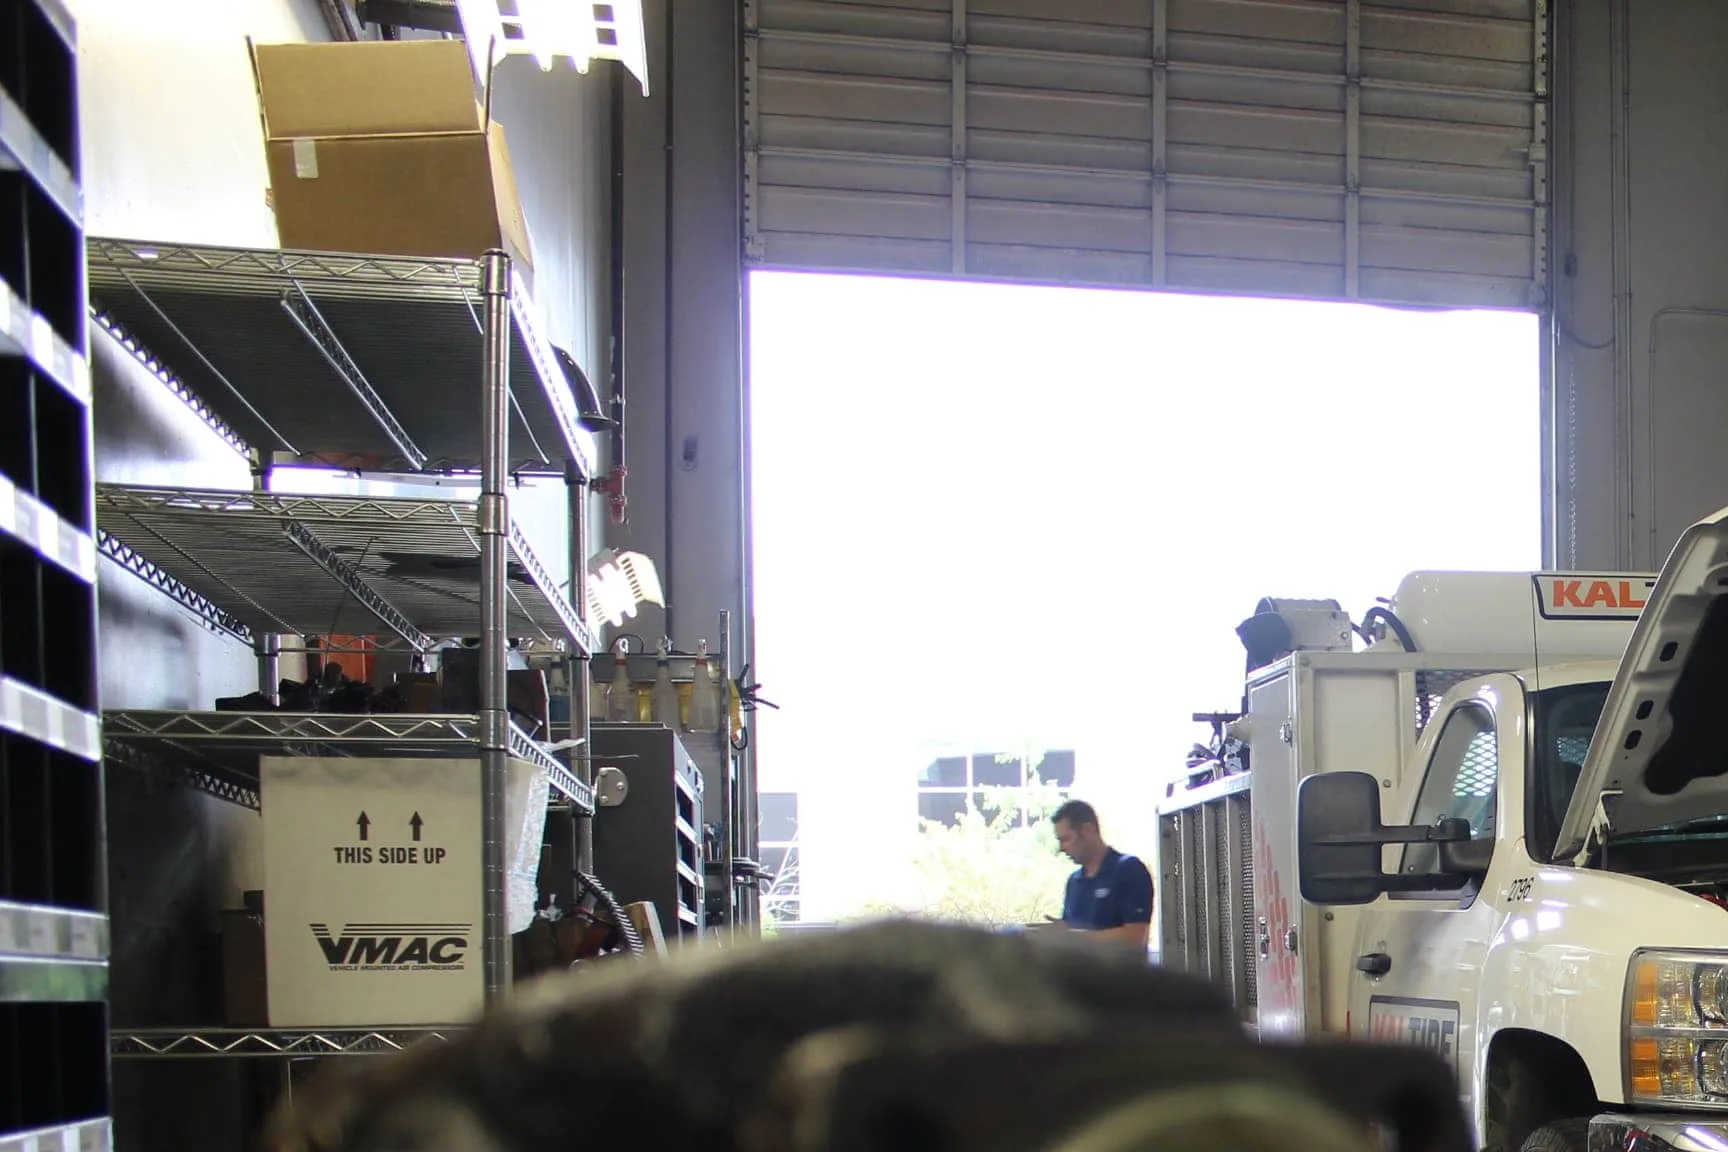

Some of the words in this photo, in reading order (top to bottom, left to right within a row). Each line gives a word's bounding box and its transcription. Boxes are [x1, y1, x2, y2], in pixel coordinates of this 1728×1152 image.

[1553, 580, 1648, 608] KAL
[334, 847, 373, 864] THIS
[379, 847, 418, 864] SIDE
[424, 847, 446, 864] UP
[1507, 877, 1534, 902] 2796
[312, 929, 469, 965] VMAC
